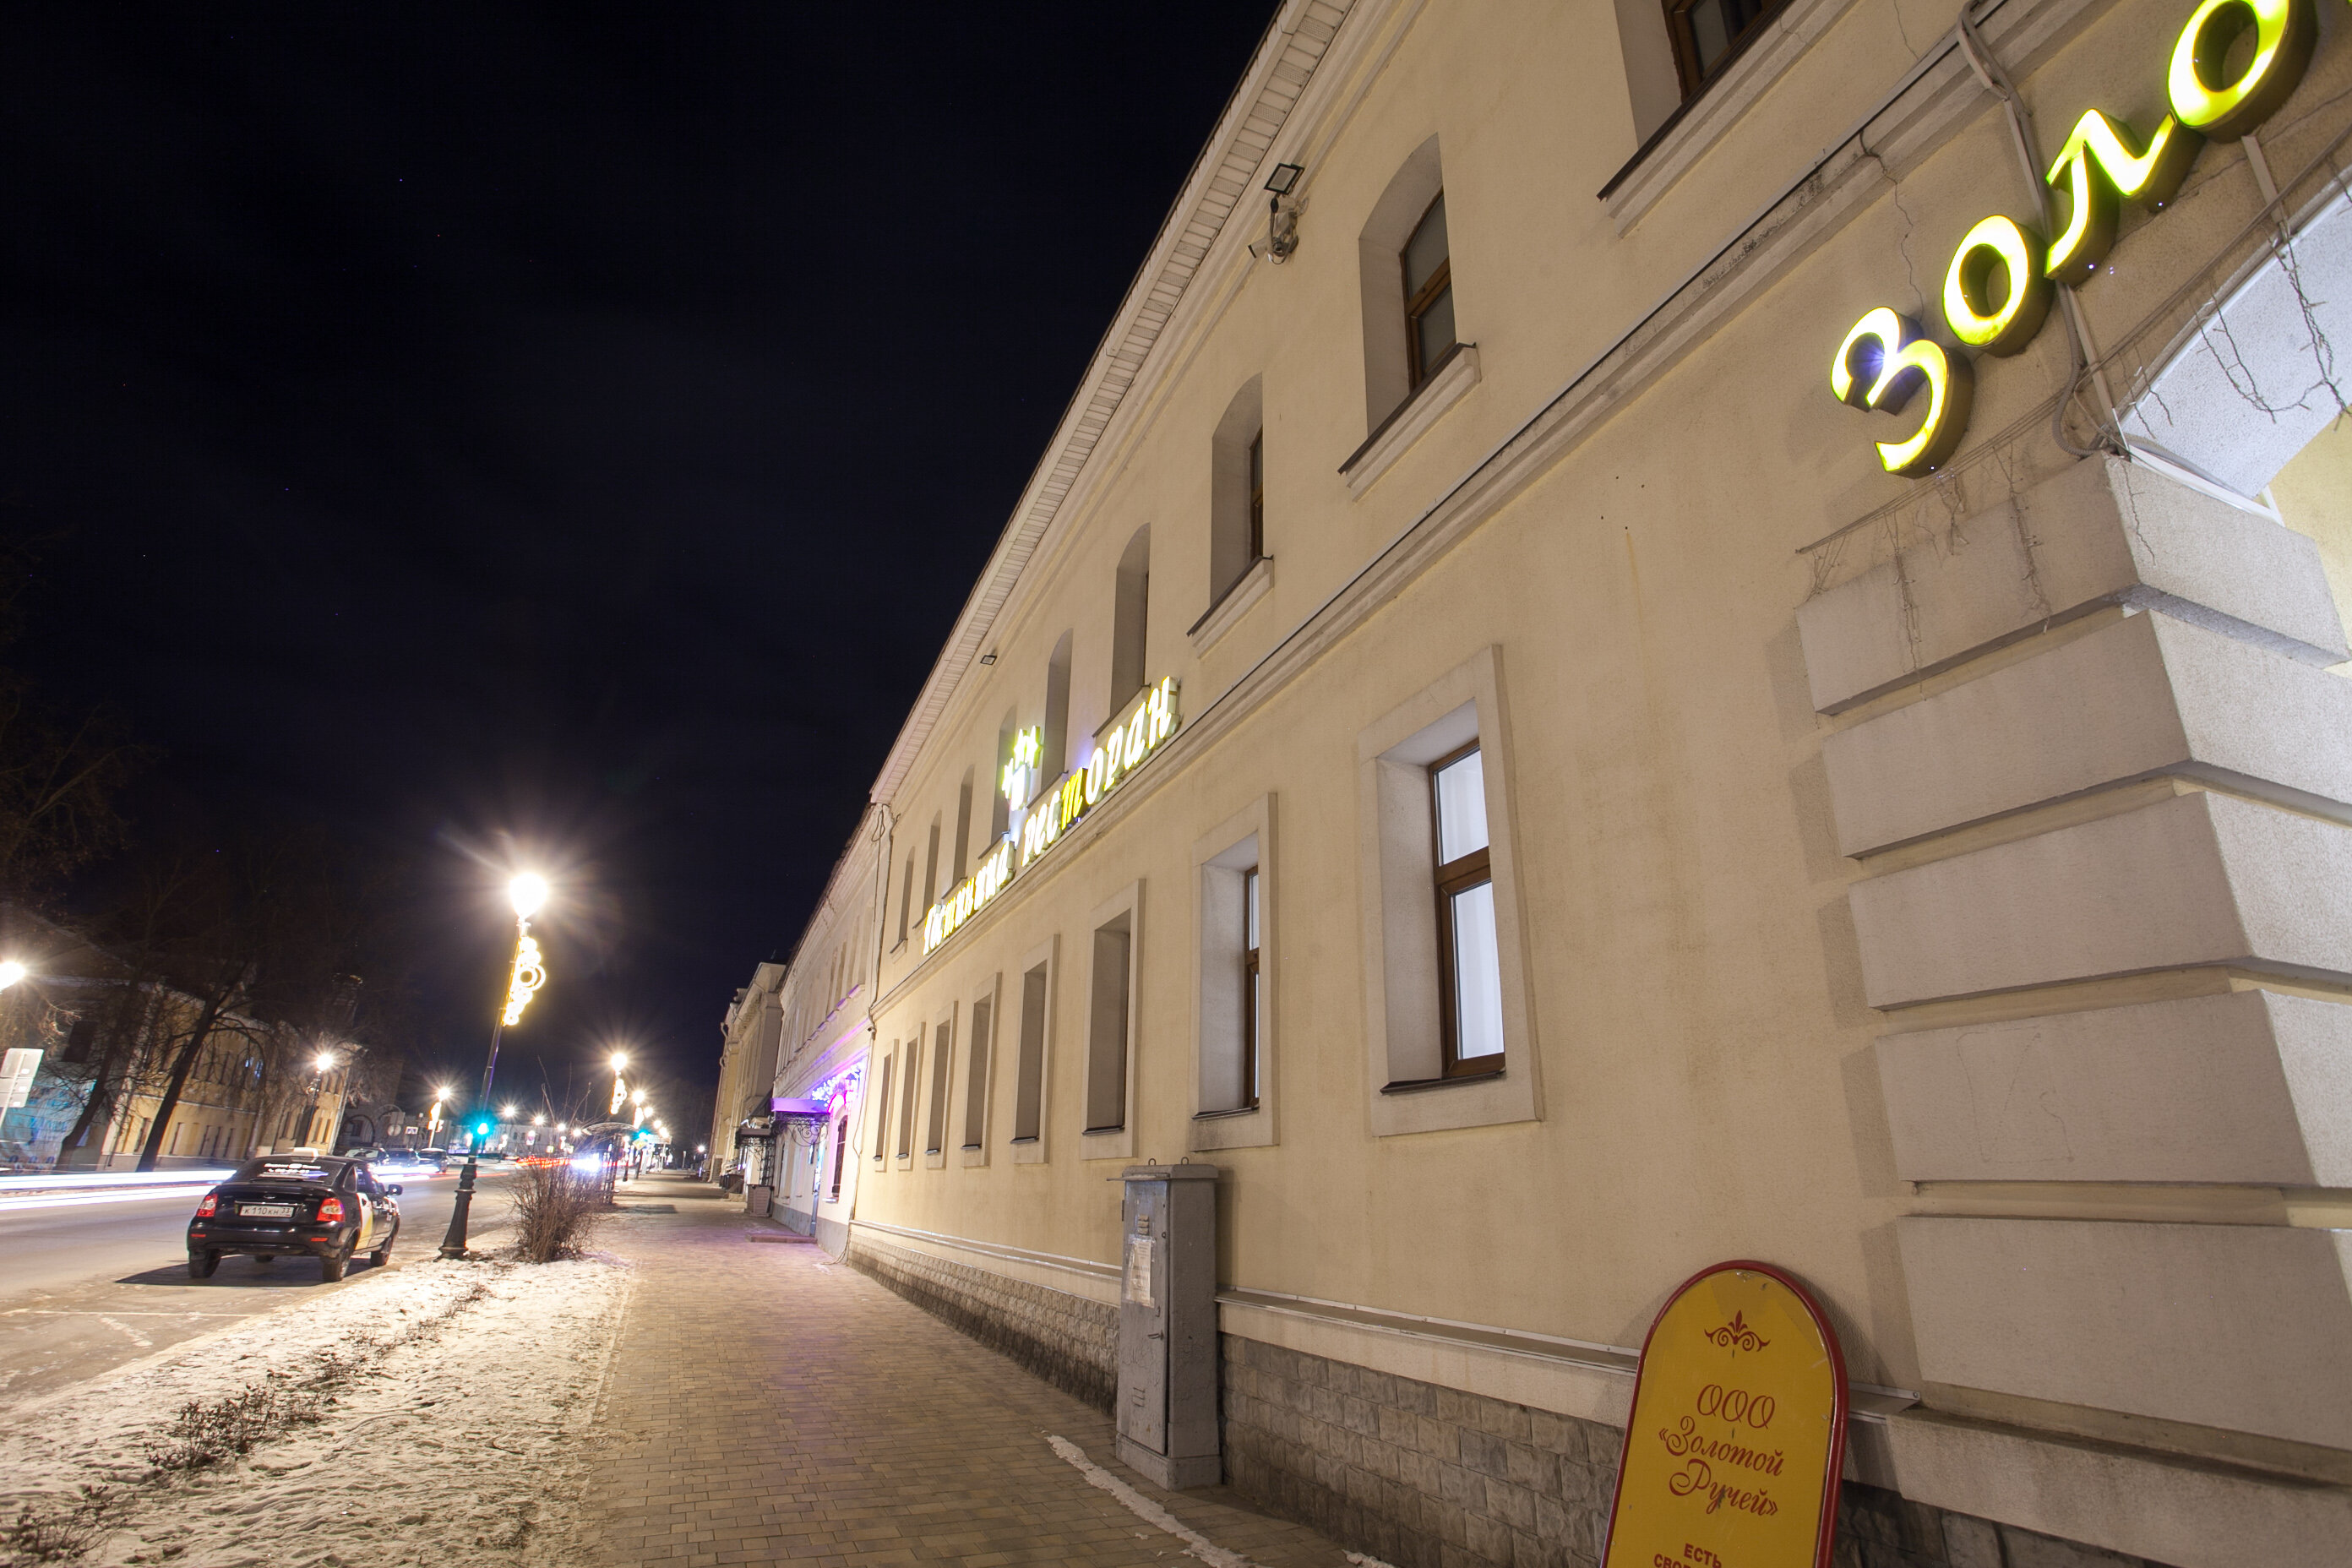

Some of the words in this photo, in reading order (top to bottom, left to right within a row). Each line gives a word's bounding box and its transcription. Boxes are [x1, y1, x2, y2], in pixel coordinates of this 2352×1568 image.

[1831, 0, 2352, 476] Золо
[1021, 676, 1172, 867] ресторан
[1696, 1384, 1776, 1429] ООО
[1658, 1415, 1784, 1477] «Золотой
[1669, 1458, 1778, 1516] Ручей»
[1684, 1543, 1723, 1568] ЕСТЬ
